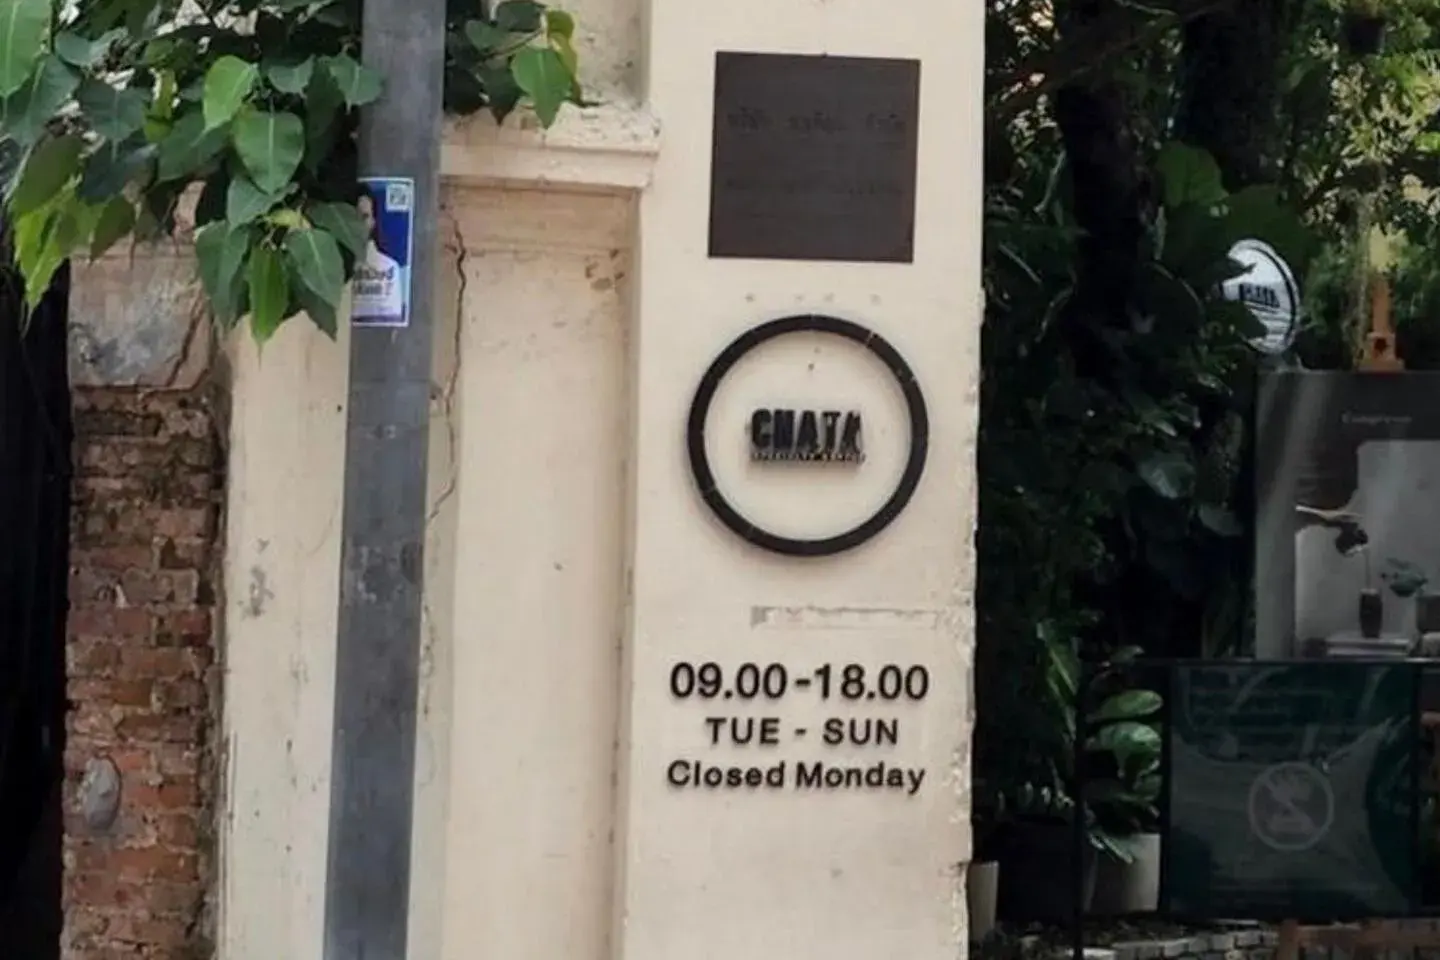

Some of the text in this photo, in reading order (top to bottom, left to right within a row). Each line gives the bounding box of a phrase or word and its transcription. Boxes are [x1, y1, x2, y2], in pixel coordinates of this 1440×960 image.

[669, 661, 930, 703] 09.00-18.00
[704, 717, 781, 746] TUE
[821, 718, 899, 747] SUN
[666, 759, 926, 797] Closed Monday
